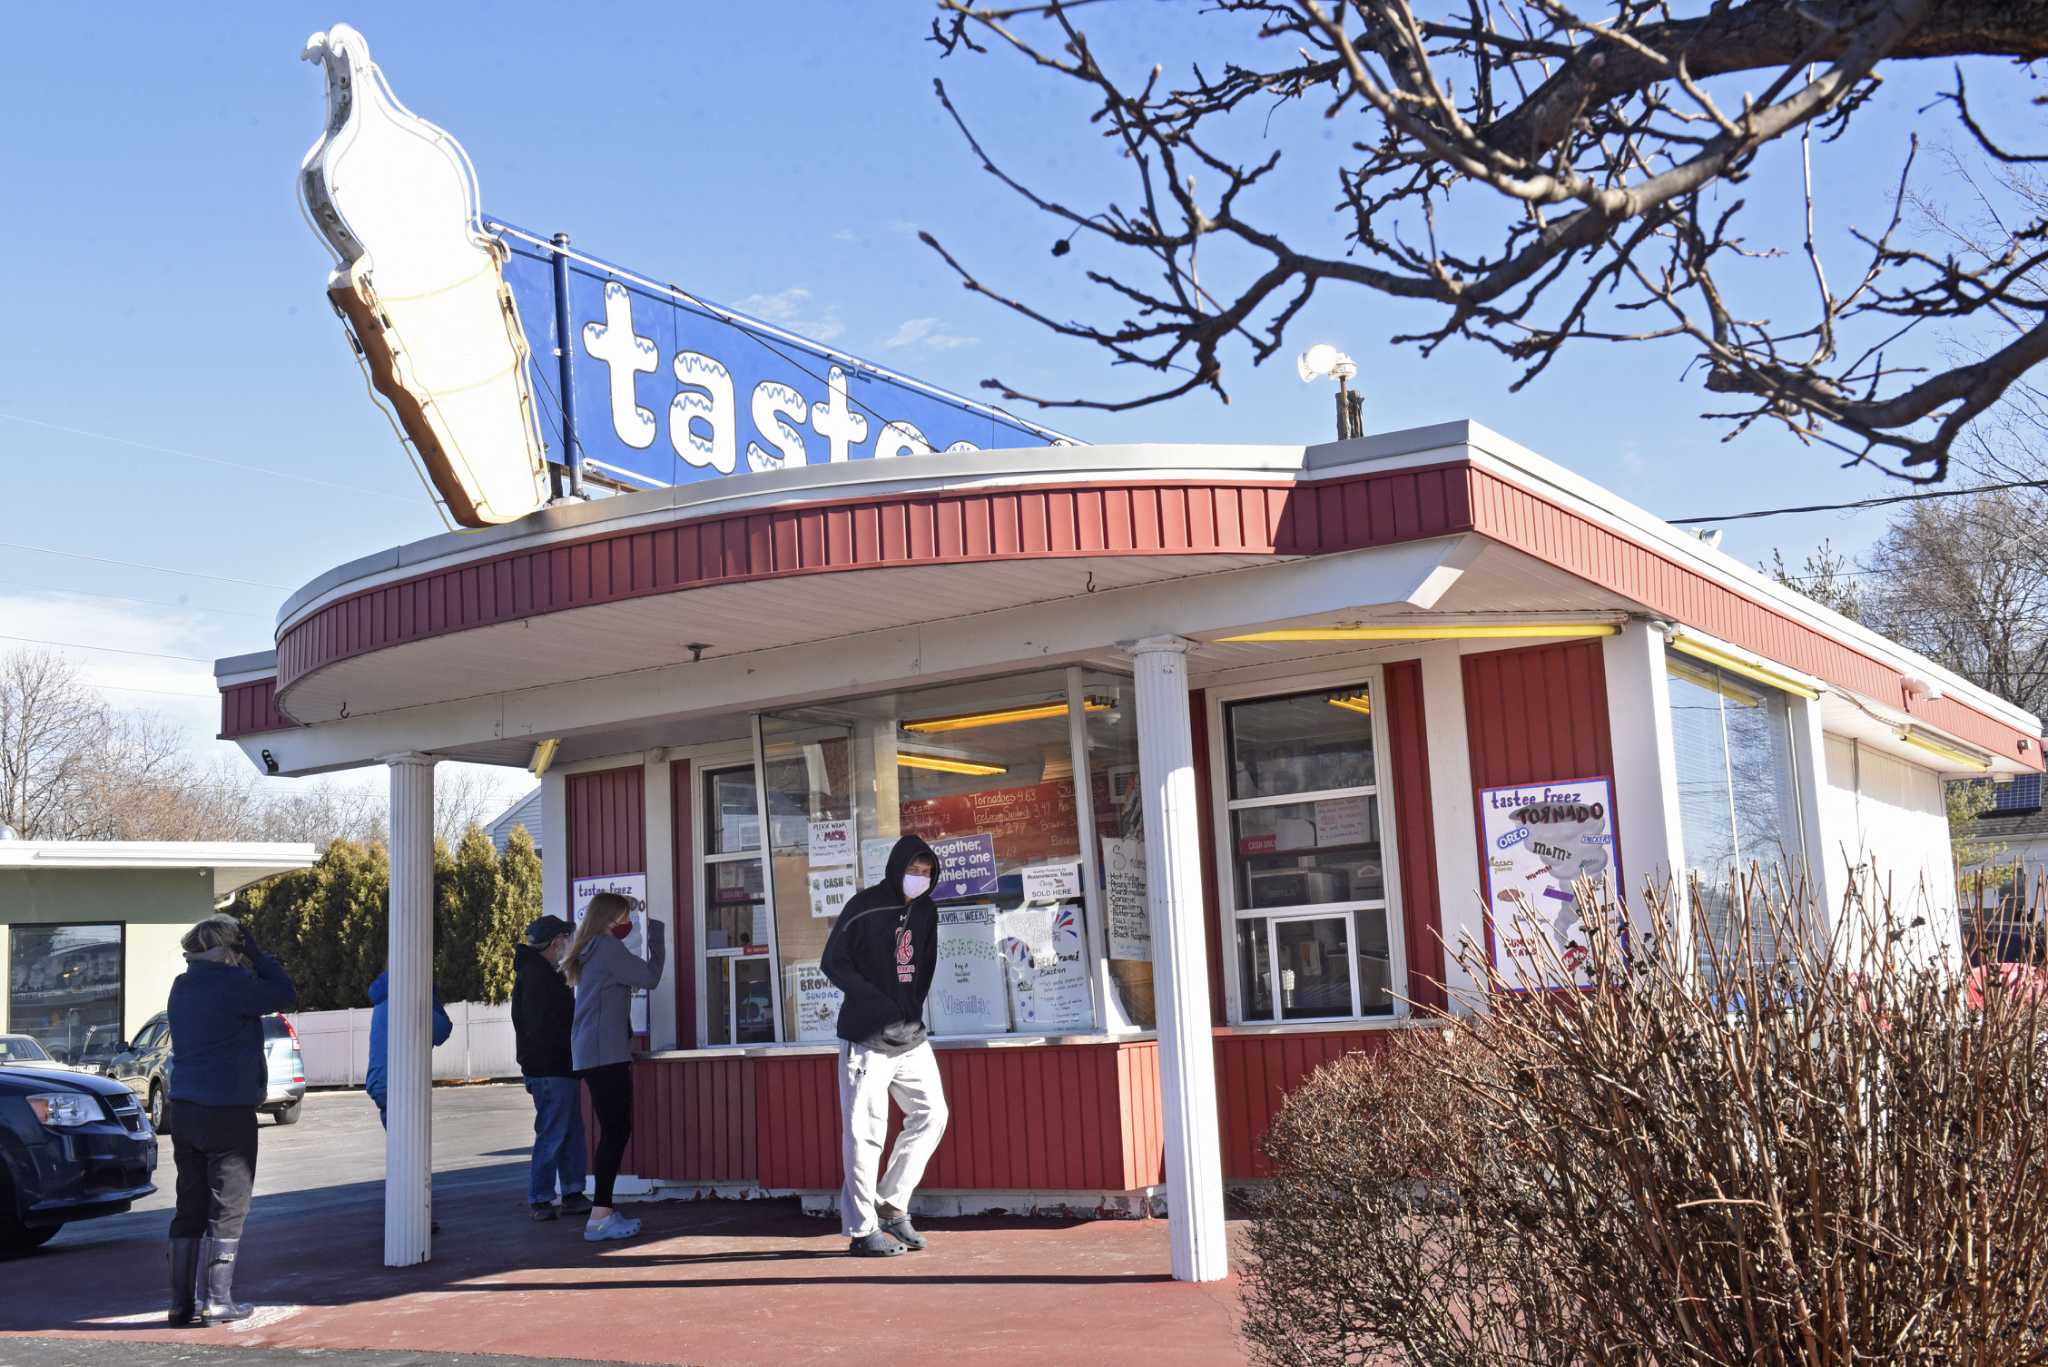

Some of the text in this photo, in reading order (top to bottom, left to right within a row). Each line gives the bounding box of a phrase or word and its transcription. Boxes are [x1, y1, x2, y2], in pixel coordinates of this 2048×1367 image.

[1544, 787, 1581, 803] freez
[1516, 802, 1604, 825] TORNADO
[1500, 828, 1528, 848] OREO
[944, 852, 991, 868] are one
[824, 877, 844, 889] CASH
[826, 894, 844, 905] ONLY
[1032, 887, 1072, 897] SOLD HERE
